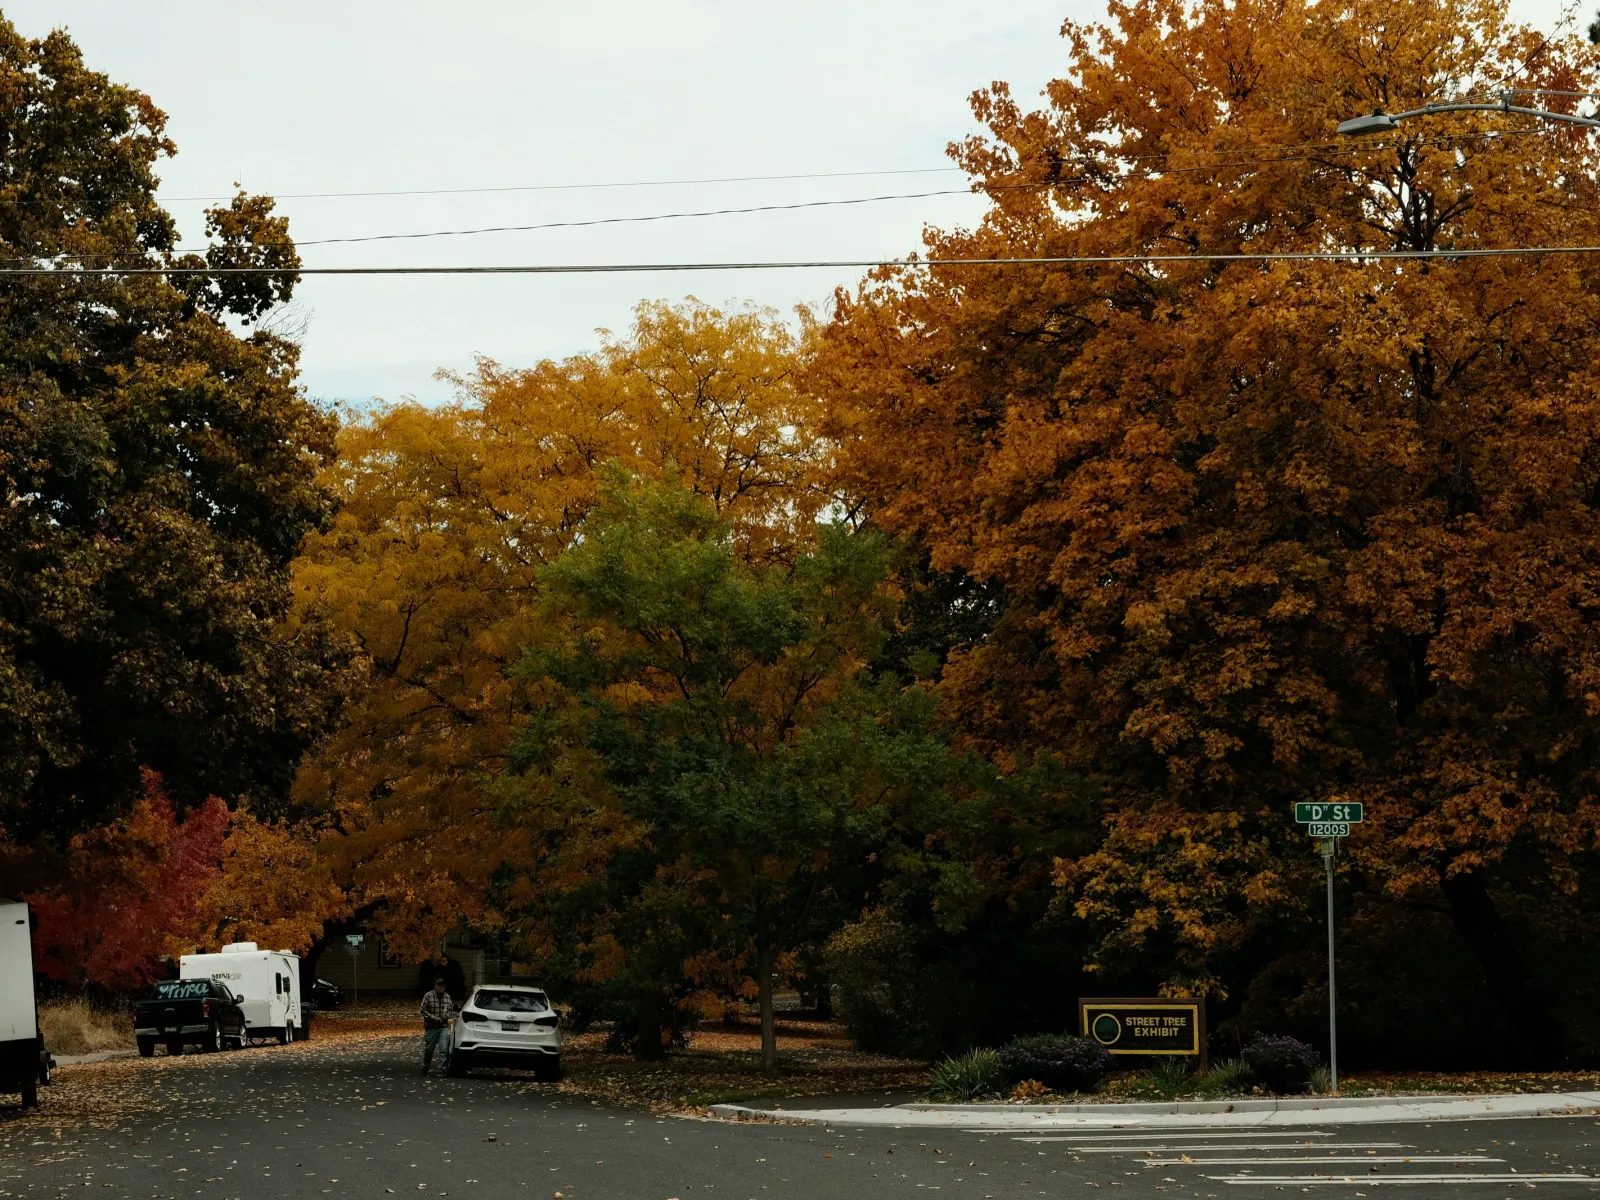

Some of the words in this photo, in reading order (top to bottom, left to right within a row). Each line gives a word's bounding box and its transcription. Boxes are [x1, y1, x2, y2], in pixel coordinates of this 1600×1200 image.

[1333, 805, 1350, 820] St
[1312, 824, 1346, 835] 1200S
[1126, 1017, 1160, 1026] STREET
[1163, 1017, 1186, 1026] TREE
[1135, 1027, 1179, 1036] EXHIBIT
